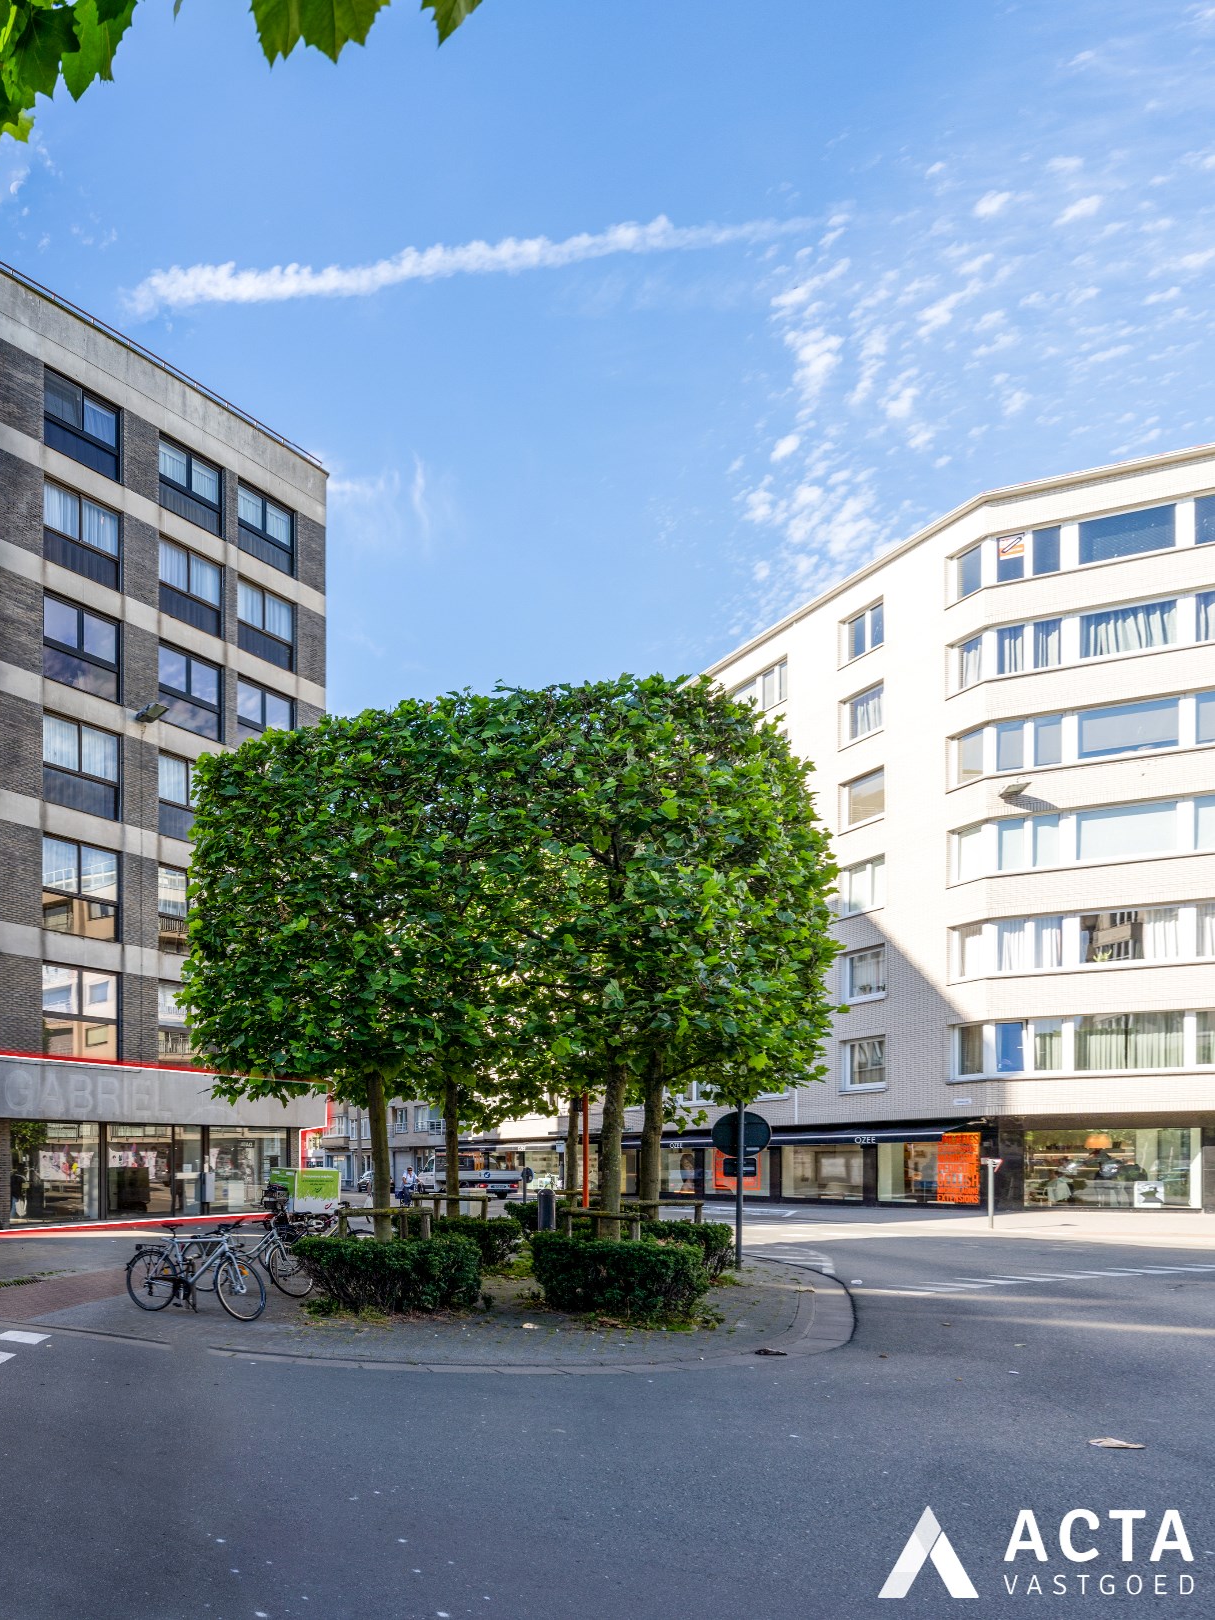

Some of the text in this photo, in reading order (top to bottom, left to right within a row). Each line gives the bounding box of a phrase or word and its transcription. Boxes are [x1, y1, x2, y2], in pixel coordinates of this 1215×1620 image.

[5, 1069, 172, 1116] GABRIEL
[854, 1136, 876, 1144] OZEE
[937, 1194, 979, 1203] EXTENSIONS
